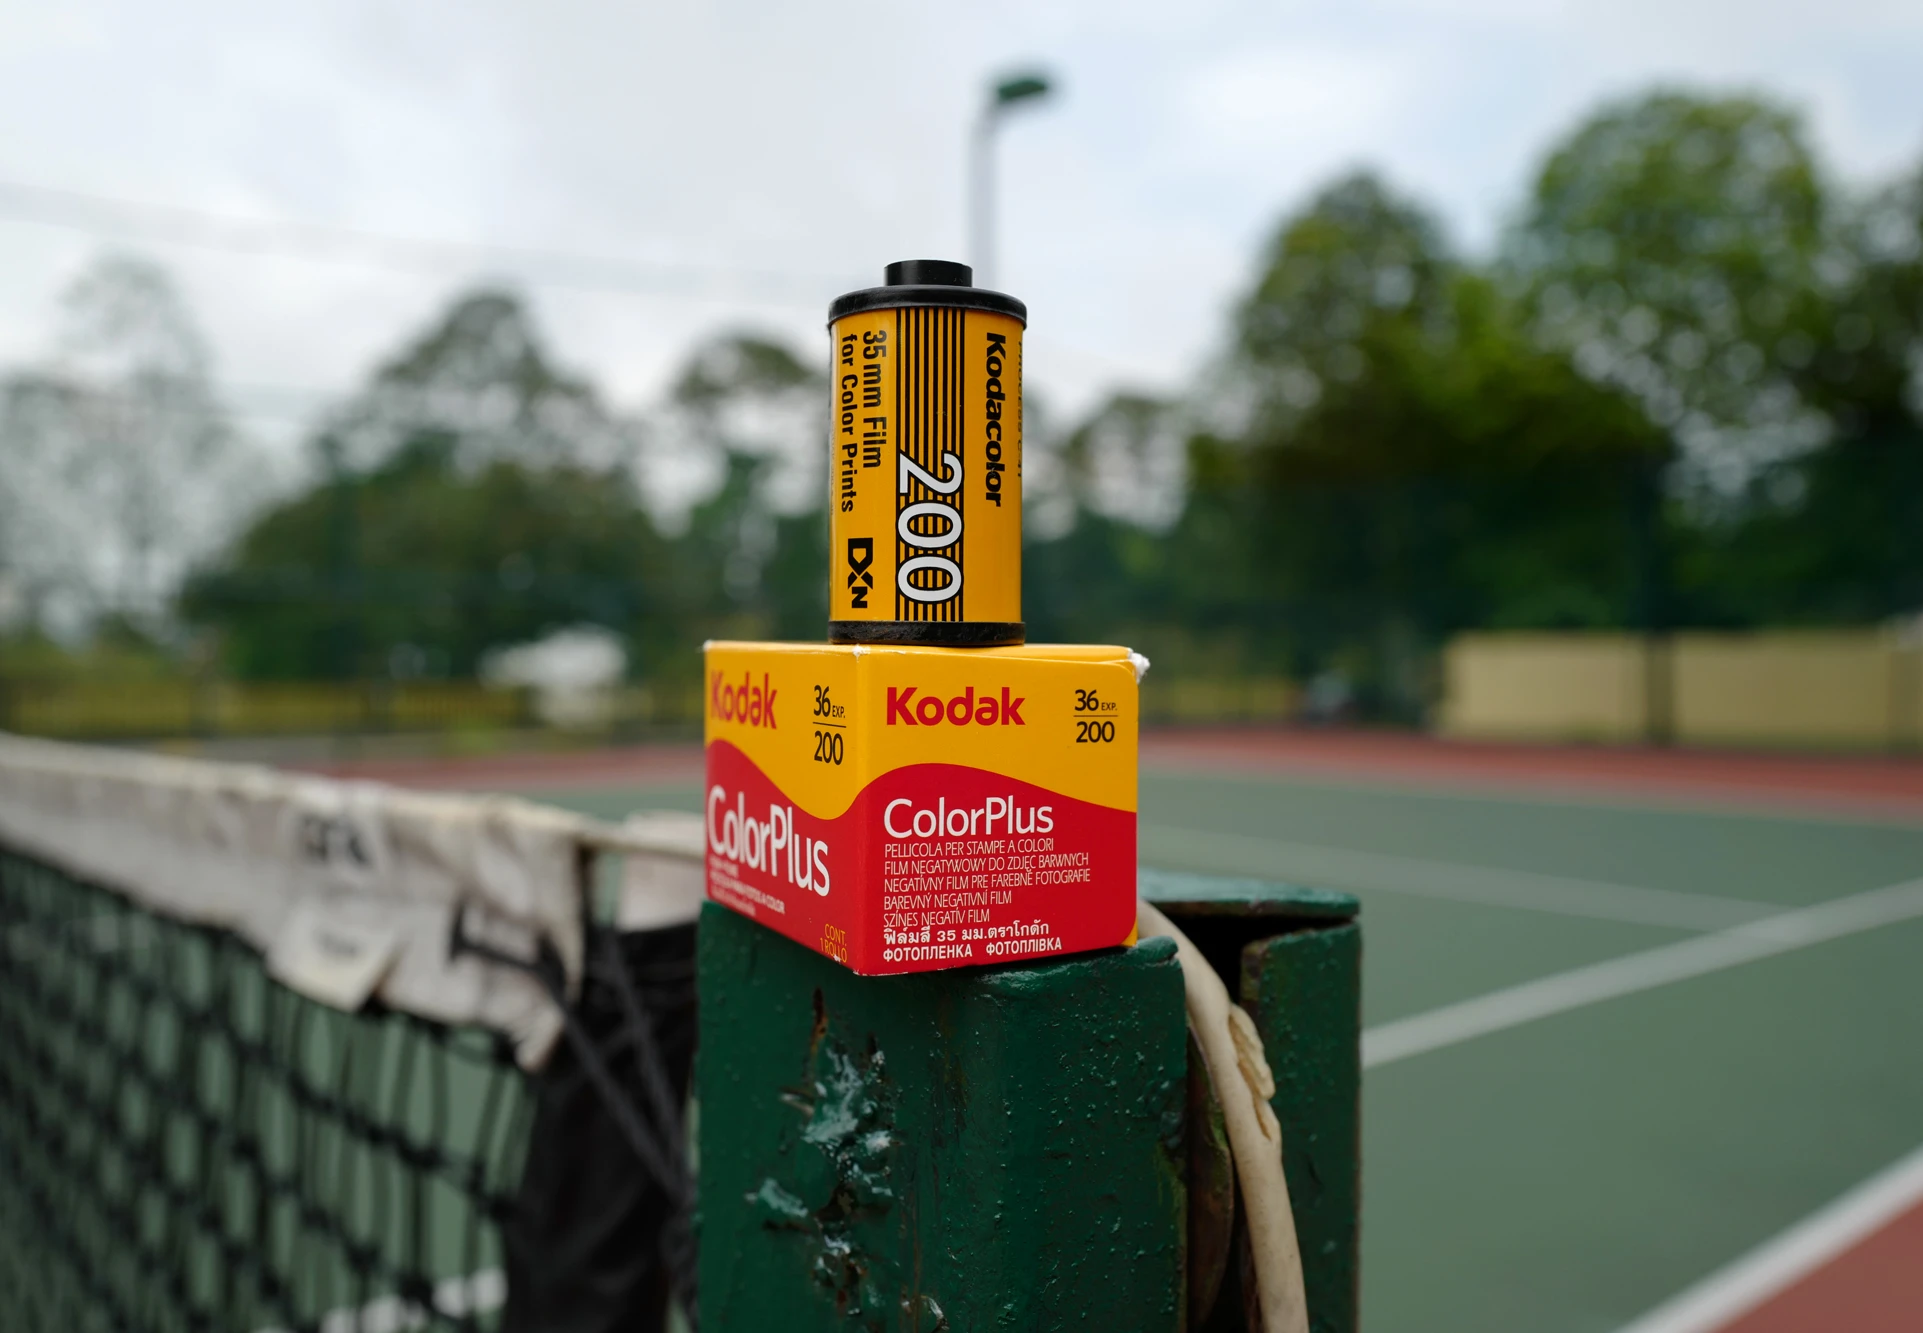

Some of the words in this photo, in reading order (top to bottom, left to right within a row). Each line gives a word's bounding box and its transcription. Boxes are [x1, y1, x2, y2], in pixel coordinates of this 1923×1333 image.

[842, 334, 857, 366] for
[842, 374, 858, 435] Color
[985, 332, 1006, 508] Kodacolor
[862, 417, 887, 468] Film
[842, 443, 858, 512] Prints
[897, 451, 963, 604] 200
[710, 669, 778, 730] Kodak
[814, 685, 831, 718] 36
[832, 705, 846, 719] EXP.
[886, 686, 1026, 726] Kodak
[1074, 689, 1100, 712] 36
[1101, 701, 1118, 712] EXP.
[814, 730, 844, 766] 200
[1075, 721, 1116, 743] 200
[883, 794, 1054, 839] ColorPlus
[707, 785, 831, 896] ColorPlus
[884, 842, 943, 858] PELLICOLA
[945, 841, 964, 856] PER
[966, 840, 1006, 855] STAMPE
[1007, 839, 1016, 854] A
[1017, 837, 1054, 853] COLORI
[884, 860, 909, 875] FILM
[911, 857, 987, 875] NEGATYWOWY
[988, 856, 1005, 872] DO
[1038, 852, 1090, 869] BARWNYCH
[884, 874, 945, 893] NEGATÍVNY
[946, 875, 969, 890] FILM
[971, 874, 989, 889] PRE
[1035, 868, 1091, 886] FOTOGRAFIE
[883, 892, 932, 911] BAREVNÝ
[934, 889, 988, 908] NEGATIVNÍ
[989, 890, 1012, 905] FILM
[883, 909, 919, 928] SZÍNES
[921, 906, 966, 926] NEGATÍV
[967, 908, 990, 924] FILM
[824, 923, 847, 947] CONT.
[883, 944, 973, 962] ФОТОПЛЕНКА
[985, 937, 1062, 956] ФОТОПЛІВКА
[936, 929, 957, 942] 35
